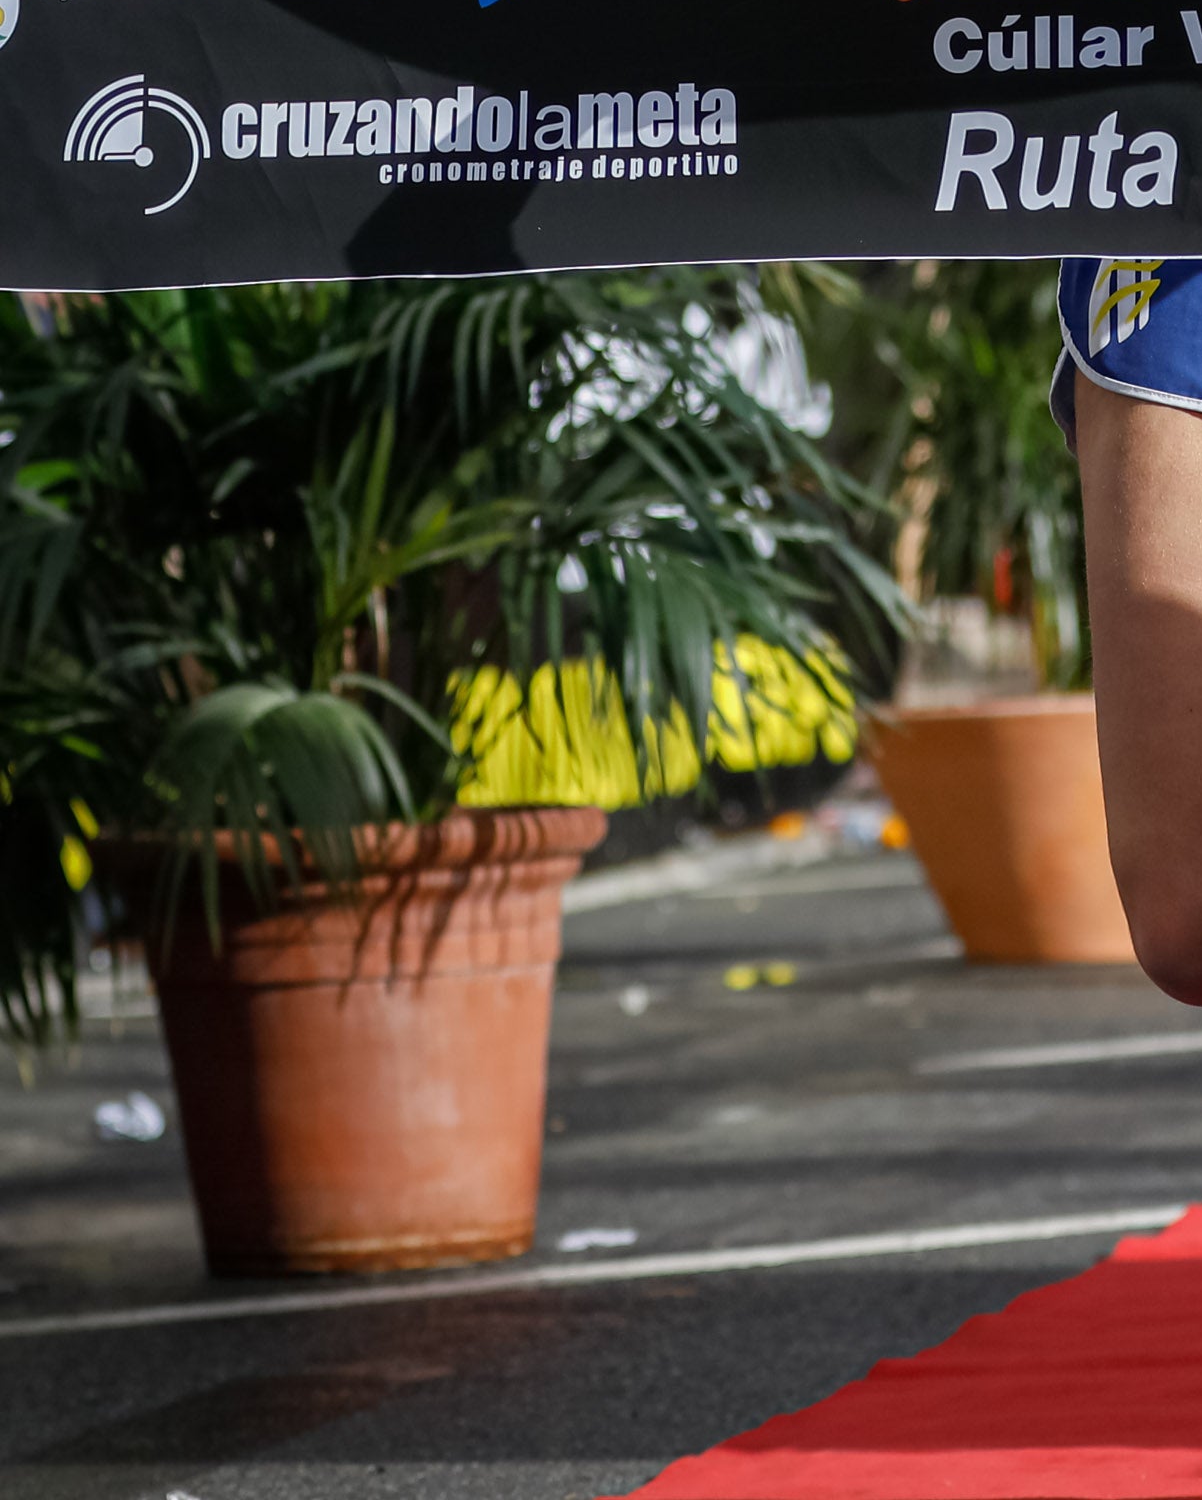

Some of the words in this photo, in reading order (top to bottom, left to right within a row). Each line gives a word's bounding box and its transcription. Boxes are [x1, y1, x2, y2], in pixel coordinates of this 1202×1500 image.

[933, 14, 1154, 74] Cúllar
[379, 156, 583, 184] cronometraje
[592, 151, 738, 181] deportivo
[935, 110, 1178, 212] Ruta
